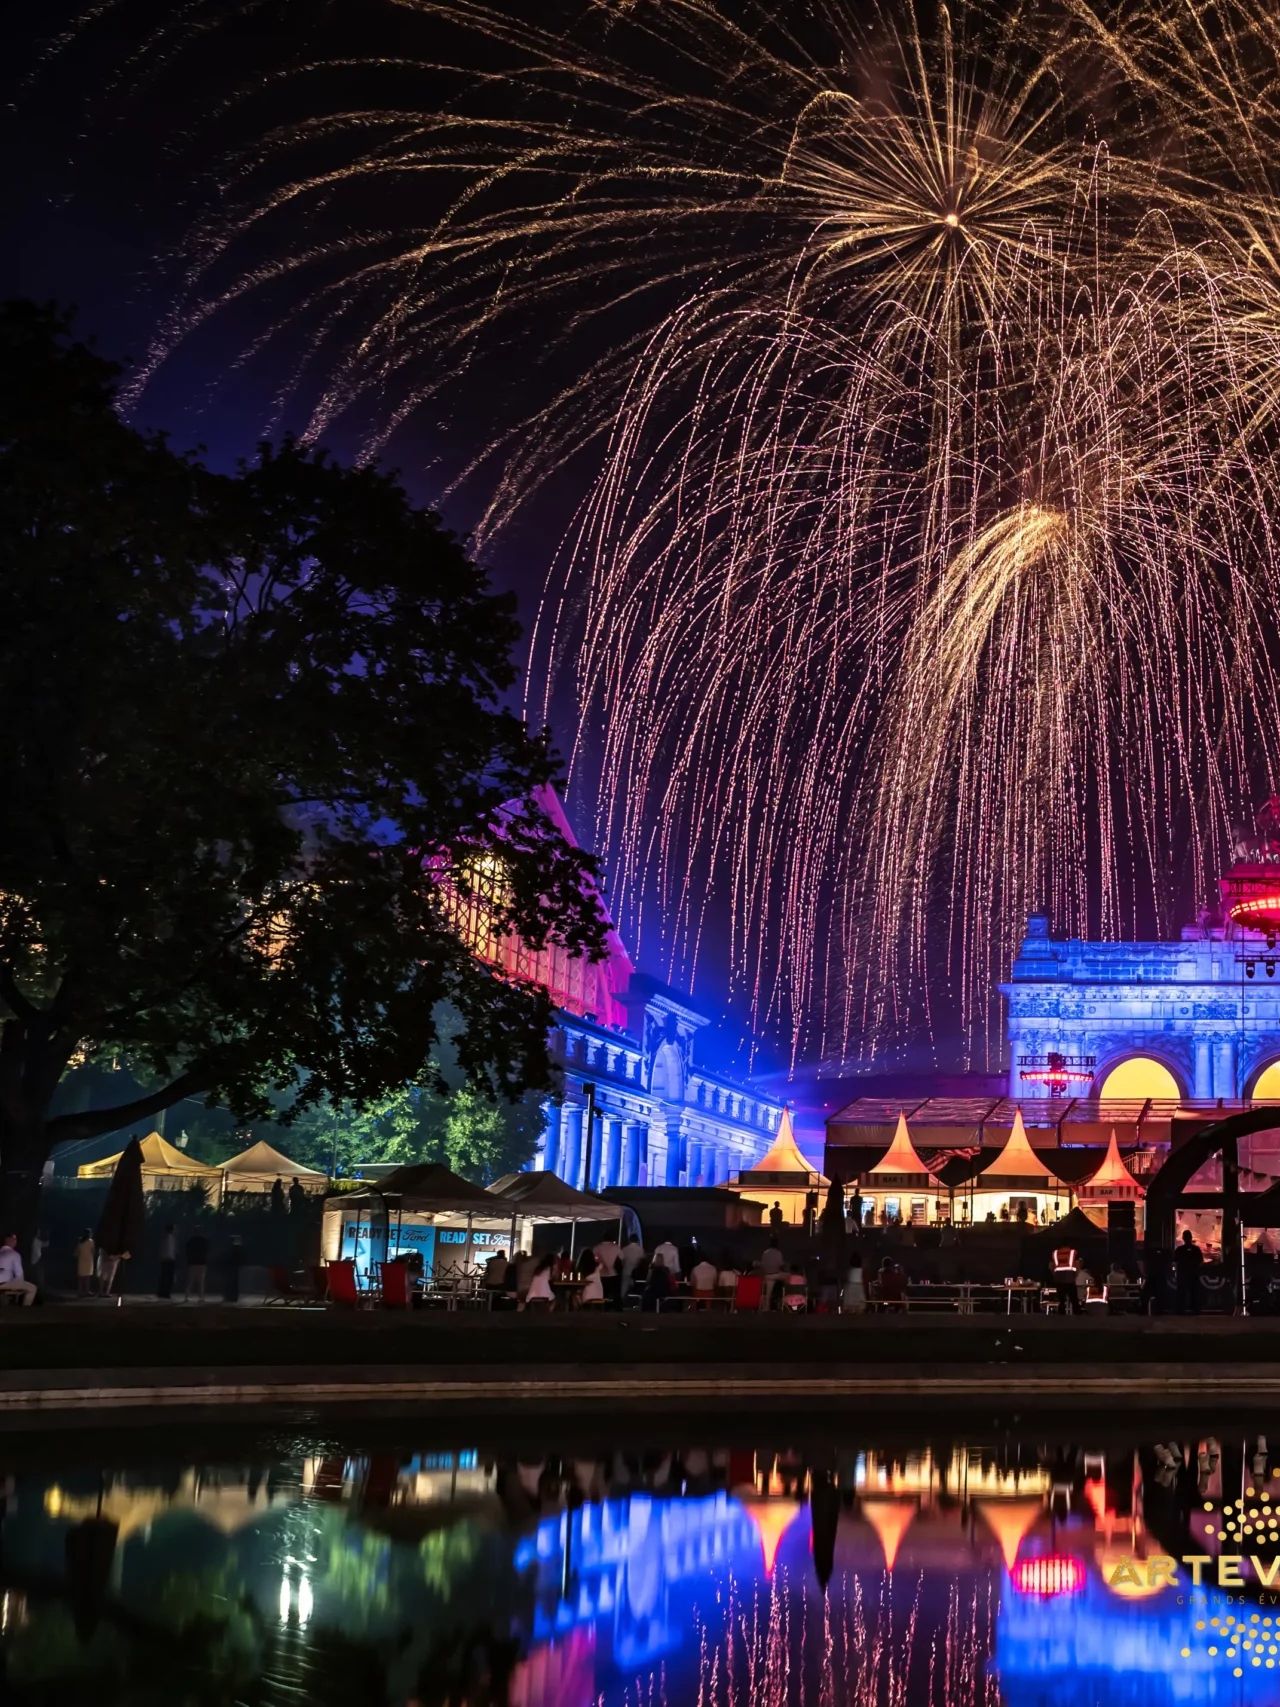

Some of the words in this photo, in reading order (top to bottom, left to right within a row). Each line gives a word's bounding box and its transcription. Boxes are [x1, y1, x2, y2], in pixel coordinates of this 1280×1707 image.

[348, 1226, 382, 1239] READY
[402, 1229, 429, 1242] Ford
[472, 1233, 491, 1245] SET
